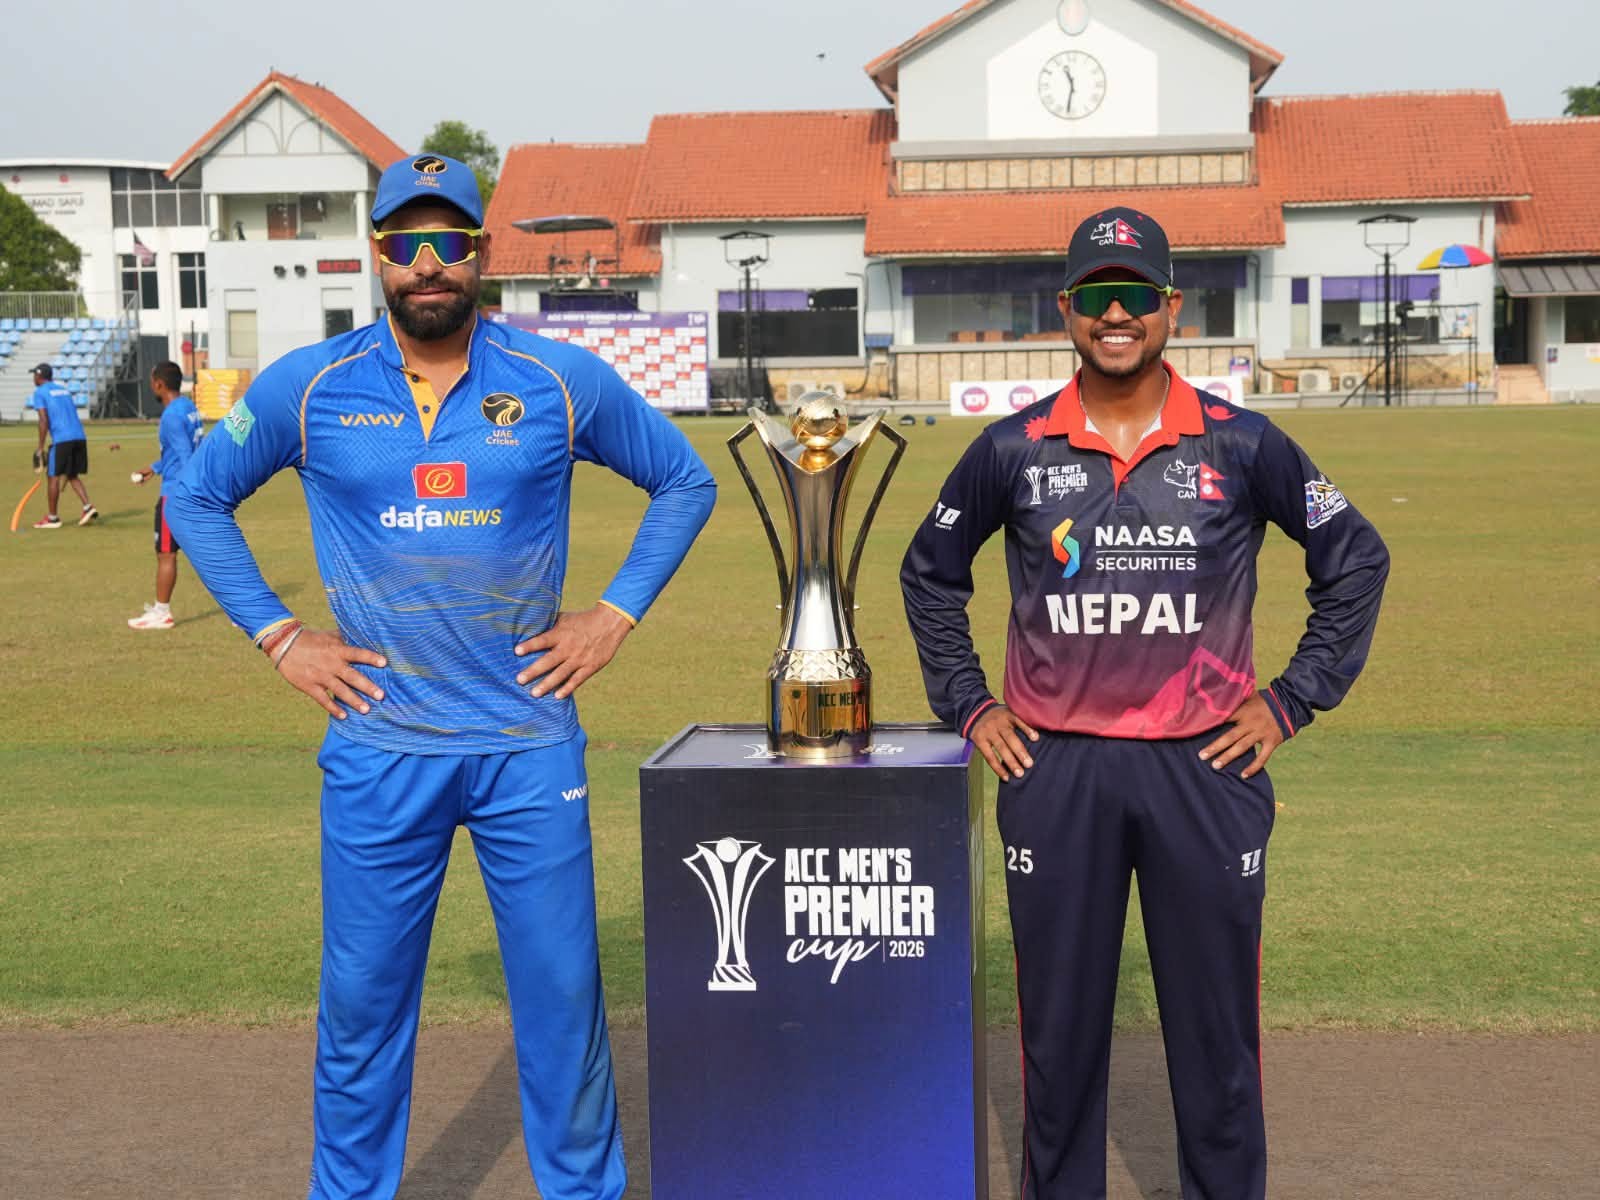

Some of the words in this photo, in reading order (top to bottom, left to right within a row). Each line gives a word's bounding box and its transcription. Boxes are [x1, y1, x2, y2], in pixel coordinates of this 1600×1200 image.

[1098, 238, 1114, 246] CAN
[486, 436, 521, 446] Cricket
[493, 429, 513, 438] UAE
[1048, 472, 1088, 489] PREMIER
[1177, 490, 1197, 499] CAN
[1095, 525, 1198, 547] NAASA
[1095, 557, 1197, 571] SECURITIES
[1045, 593, 1204, 635] NEPAL
[784, 848, 830, 882] ACC
[838, 848, 912, 882] MEN'S
[1007, 845, 1034, 874] 25
[784, 885, 935, 937] PREMIER
[786, 938, 881, 984] cup
[889, 940, 925, 957] 2026
